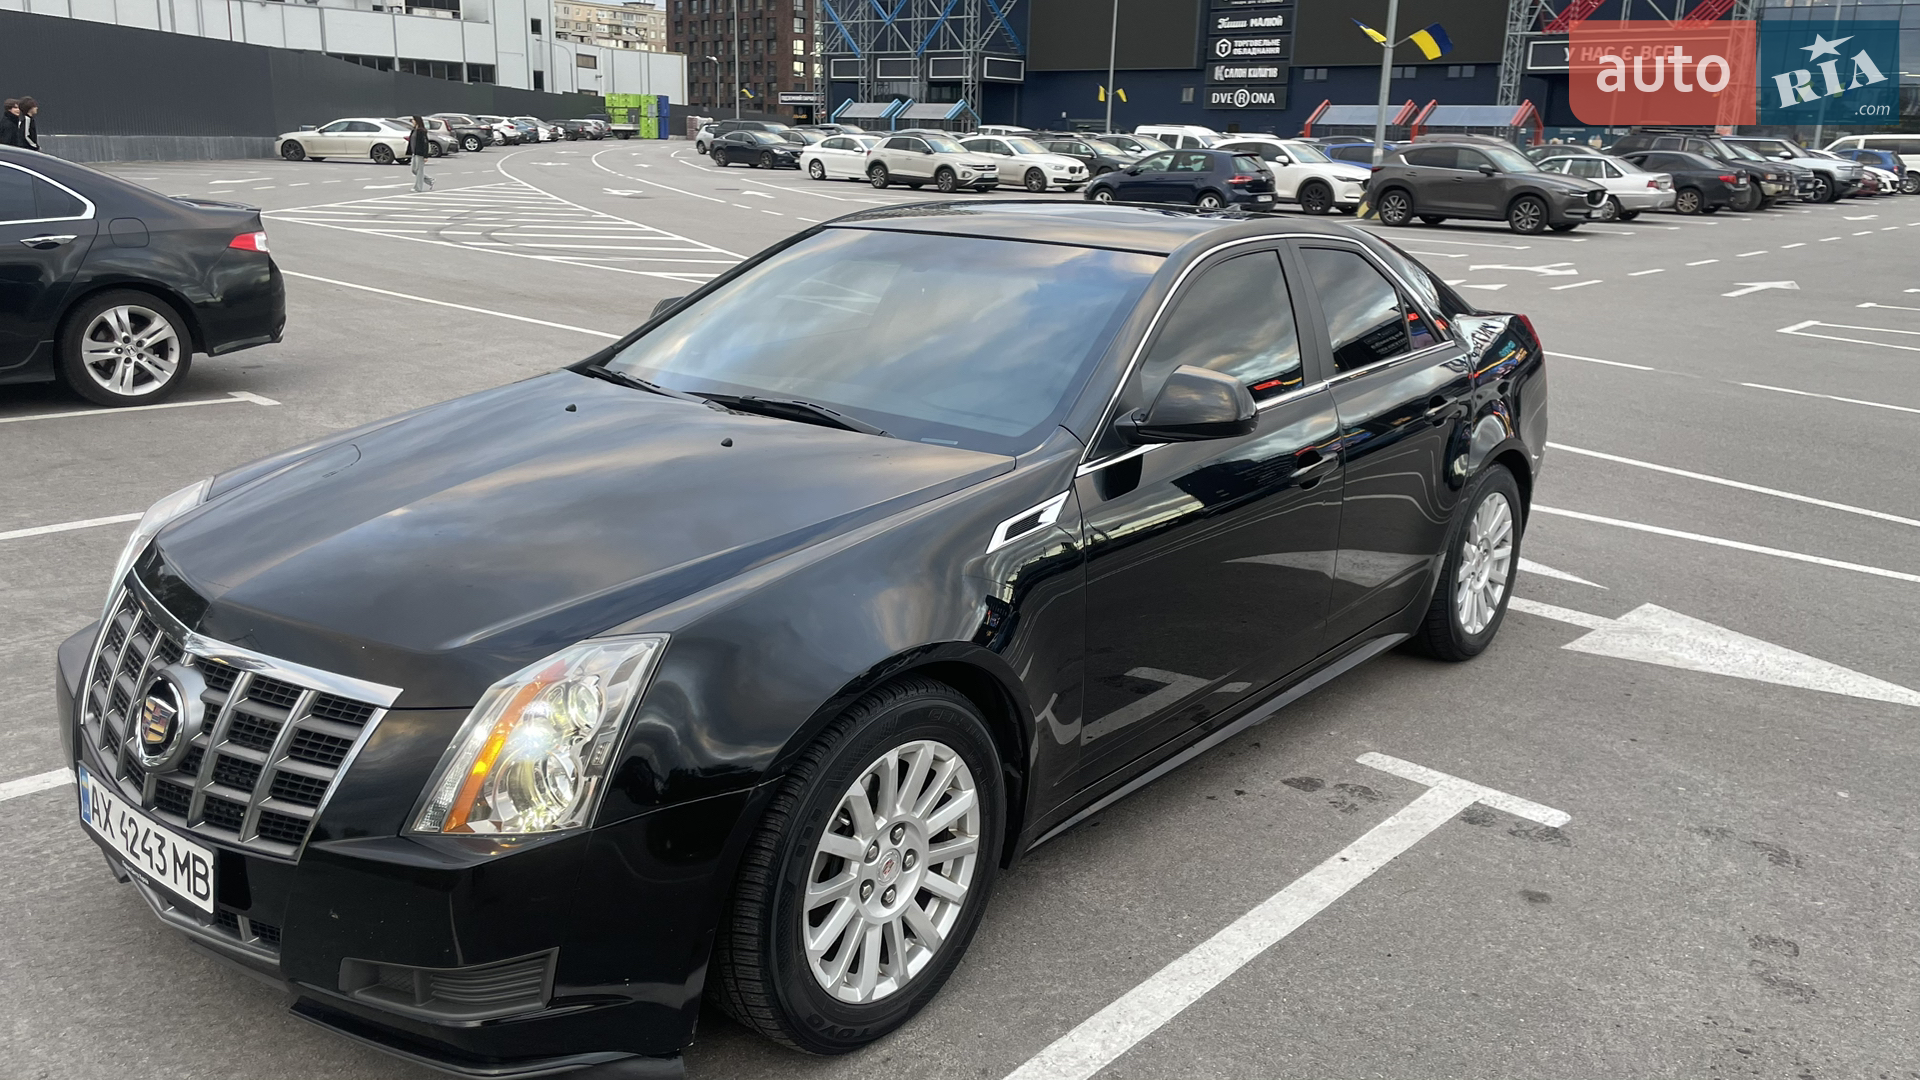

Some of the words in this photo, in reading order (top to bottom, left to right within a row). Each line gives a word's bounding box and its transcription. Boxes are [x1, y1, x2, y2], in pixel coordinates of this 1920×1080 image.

[1563, 47, 1575, 62] У
[1580, 46, 1615, 61] НАС
[1621, 46, 1634, 61] Є
[92, 785, 115, 839] AX
[120, 811, 167, 876] 4243
[173, 842, 210, 902] MB
